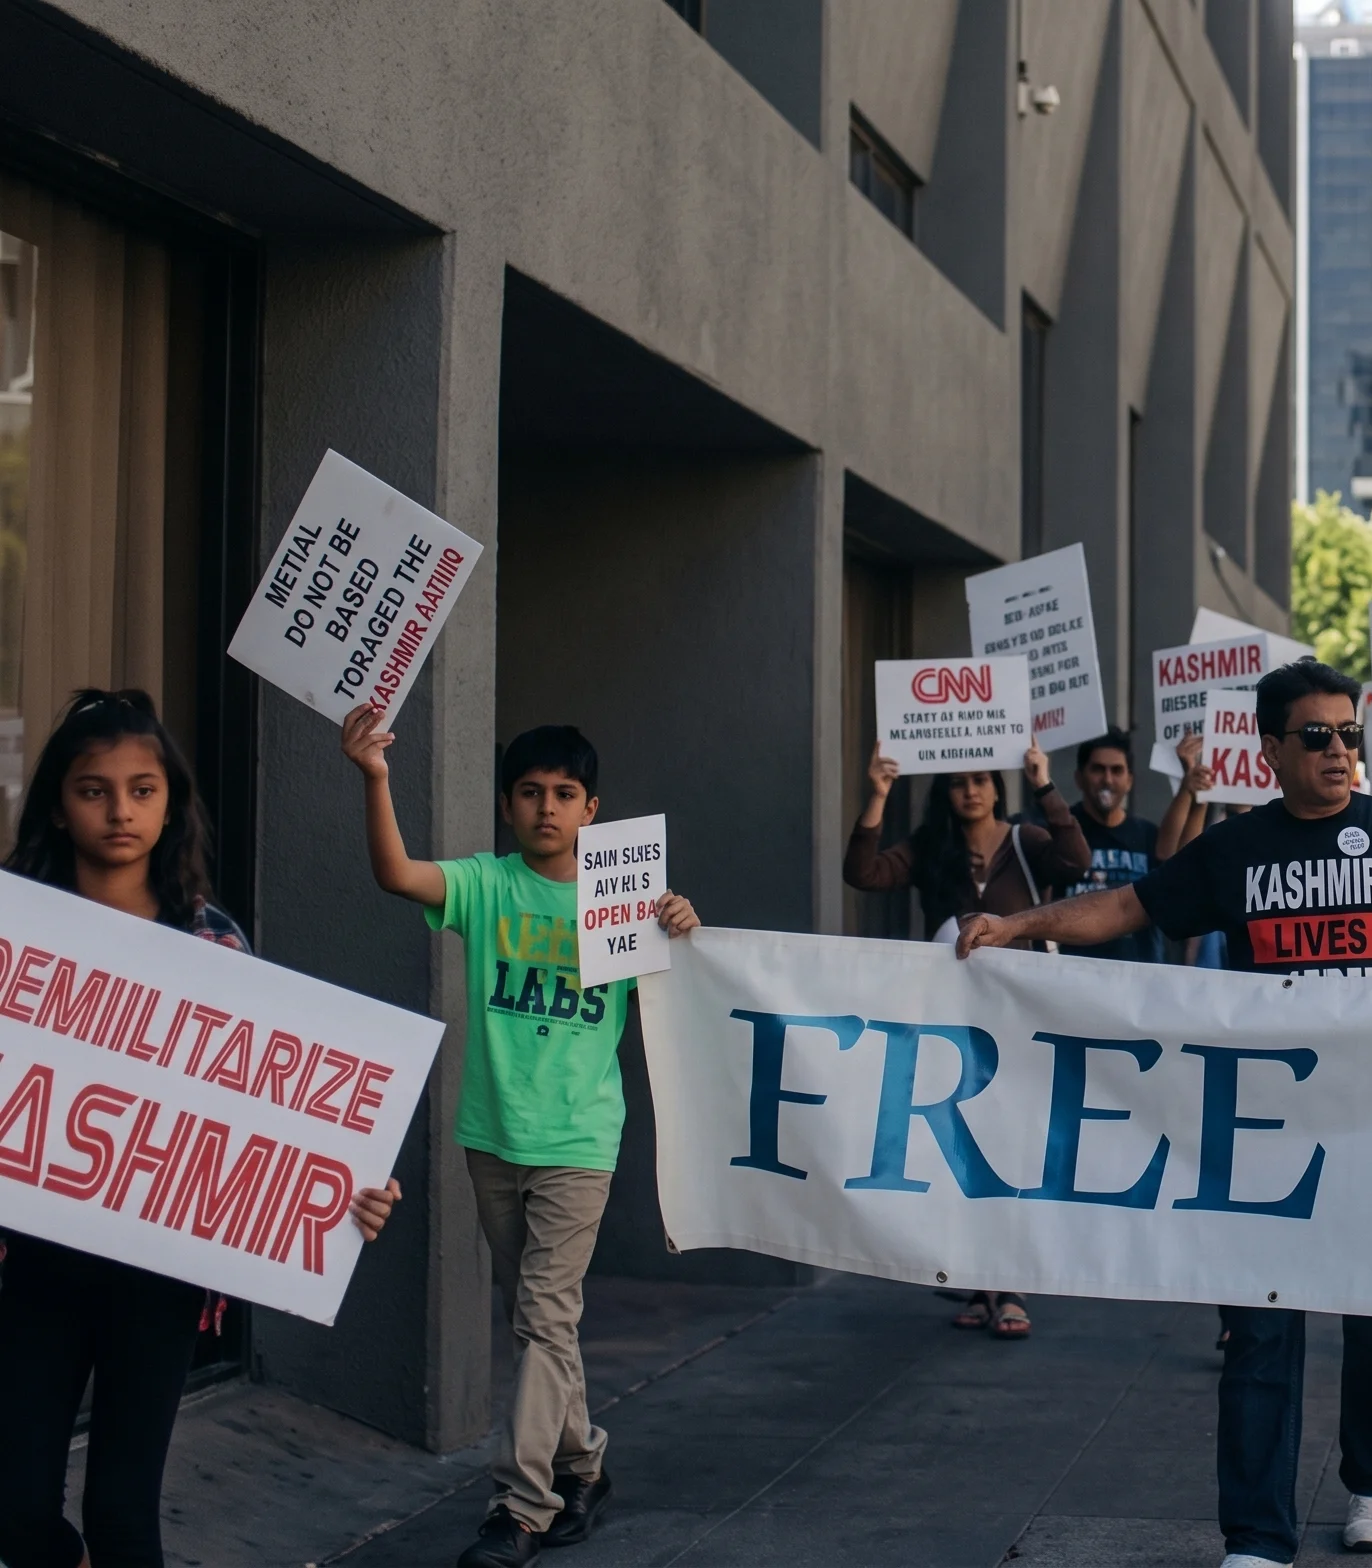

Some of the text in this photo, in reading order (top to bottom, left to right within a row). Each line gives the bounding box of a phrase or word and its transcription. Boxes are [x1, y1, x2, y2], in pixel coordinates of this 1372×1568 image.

[264, 524, 322, 609] METIAL
[284, 517, 361, 649] DO NOT BE
[324, 558, 379, 643] BASED
[333, 534, 432, 700] TORAGED THE
[369, 619, 428, 712] KASHMIR
[911, 664, 992, 704] CNN
[1158, 644, 1262, 687] KASHMIR
[1211, 748, 1281, 790] KAS
[584, 849, 617, 870] SAIN
[585, 903, 630, 930] OPEN
[607, 933, 637, 955] YAE
[1274, 919, 1367, 958] LIVES
[729, 1008, 1326, 1220] FREE
[0, 1053, 353, 1275] ASHMIR
